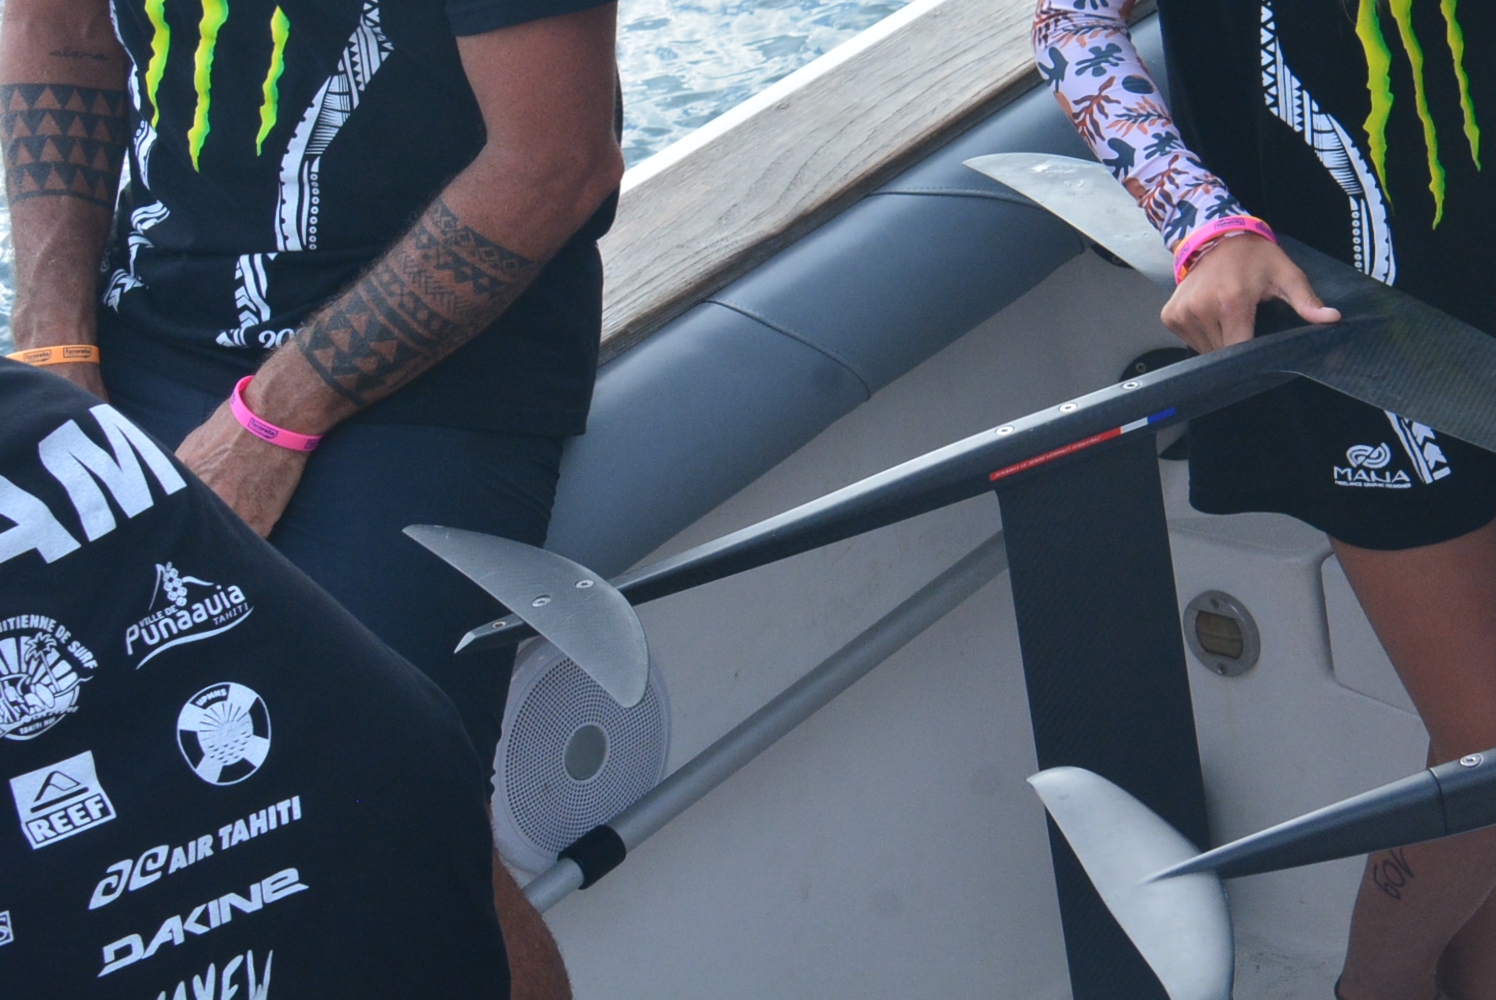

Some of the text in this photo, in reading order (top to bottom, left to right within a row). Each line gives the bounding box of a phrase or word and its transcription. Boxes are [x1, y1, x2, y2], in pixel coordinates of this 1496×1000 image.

[139, 604, 178, 627] VILLE DE
[213, 602, 249, 625] TAHITI
[0, 614, 98, 669] ITIENNE DE SURF
[27, 796, 105, 843] REEF
[168, 795, 302, 875] AIR TAHITI
[98, 868, 309, 977] DAKINE
